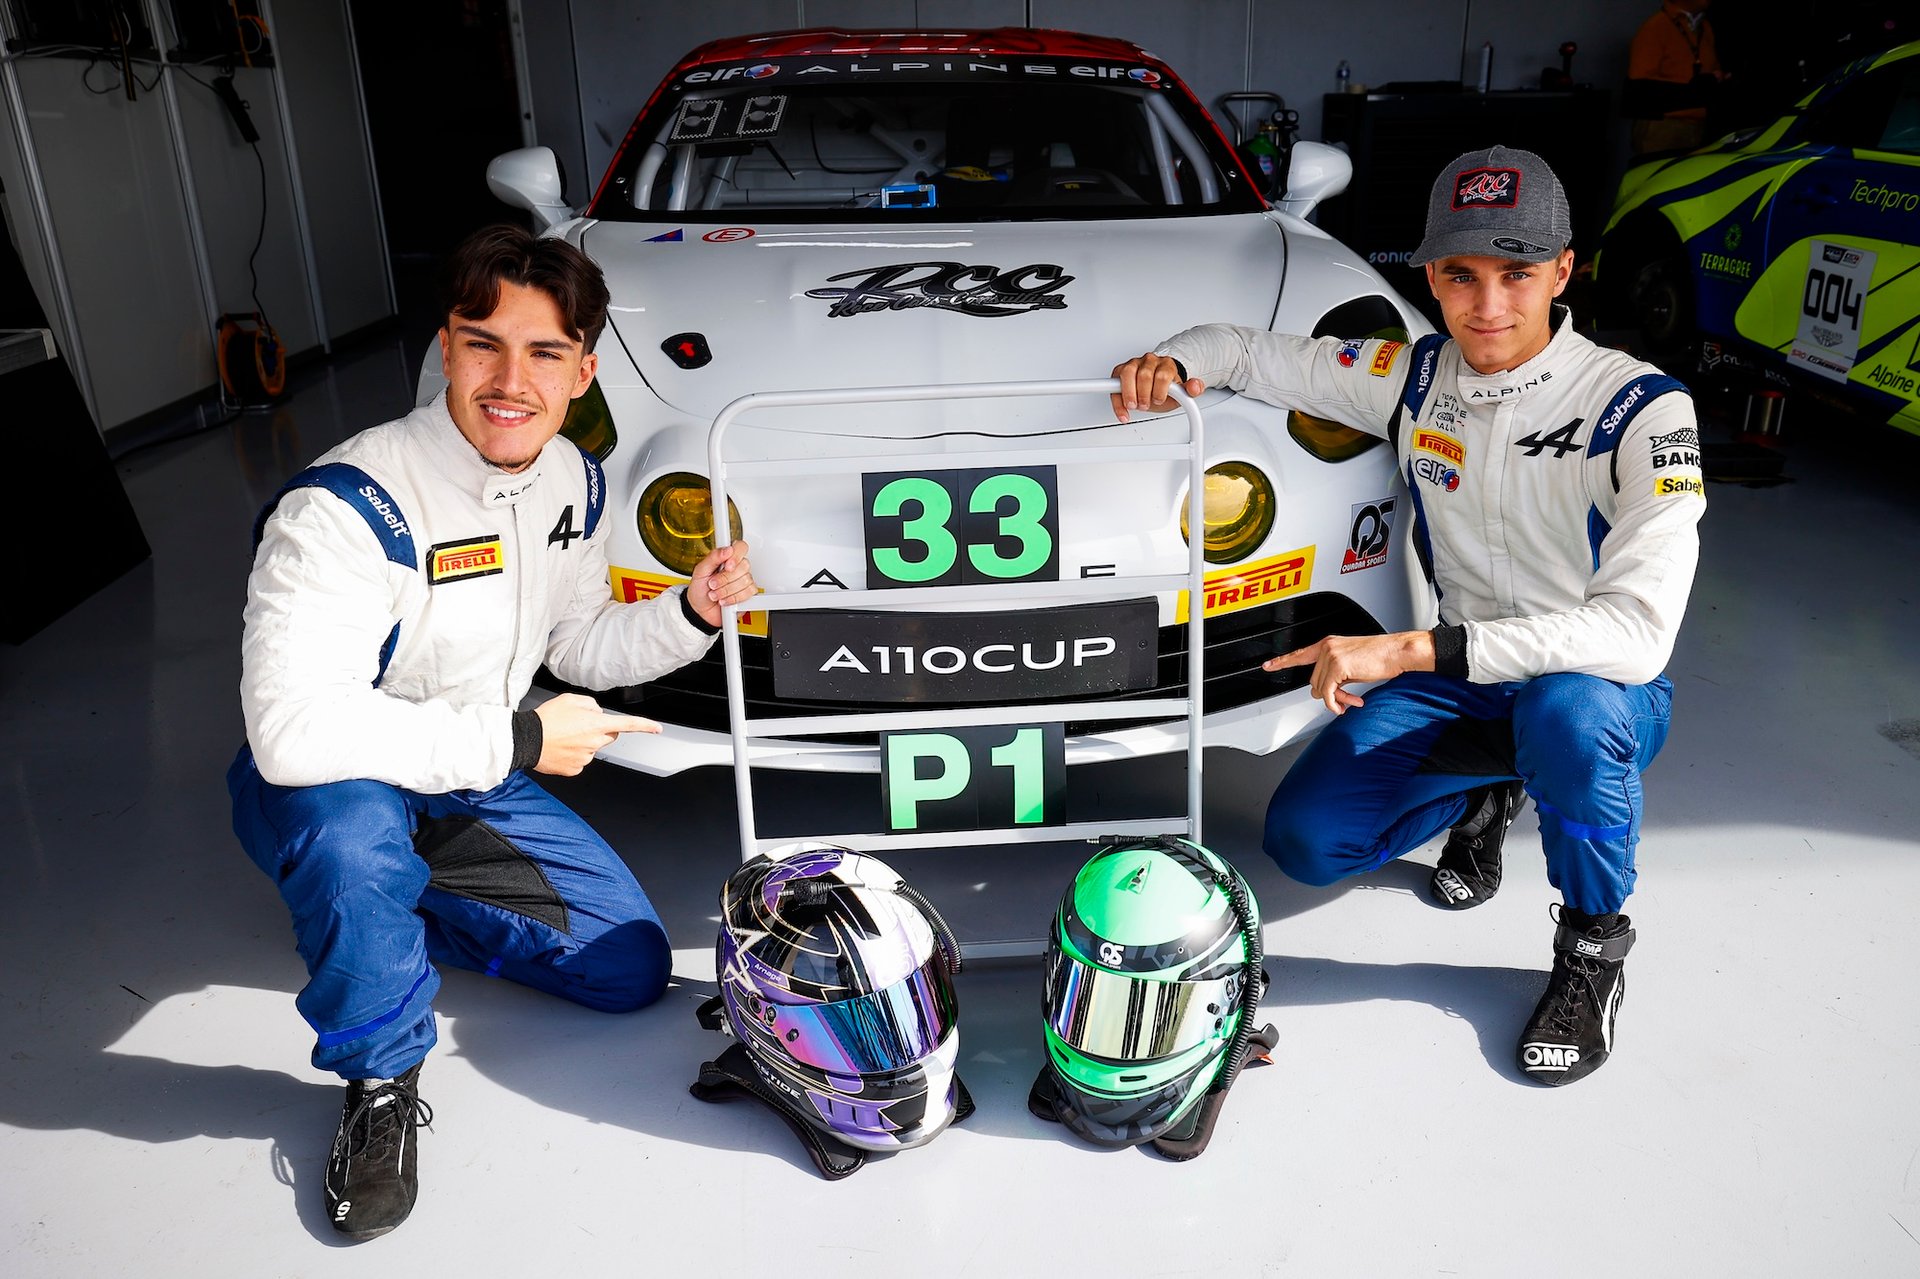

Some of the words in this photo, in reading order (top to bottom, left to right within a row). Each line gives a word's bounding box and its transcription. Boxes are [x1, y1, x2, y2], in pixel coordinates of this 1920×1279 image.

[685, 67, 745, 83] elf
[796, 62, 1057, 76] ALPINE
[1069, 65, 1125, 79] elf
[1849, 178, 1920, 212] Techpro
[1803, 268, 1862, 331] 004
[1471, 371, 1553, 399] ALPINE
[1867, 363, 1914, 393] Alpine
[1601, 383, 1645, 435] Sabelt
[1418, 433, 1463, 464] PIRELLI
[1416, 458, 1447, 486] elf
[358, 485, 410, 538] Sabelt
[871, 473, 1053, 583] 33
[438, 547, 496, 573] PIRELLI
[818, 636, 1116, 675] A110CUP
[886, 728, 1044, 830] P1
[1437, 869, 1469, 900] OMP
[1576, 941, 1602, 955] OMP
[1523, 1047, 1580, 1067] OMP
